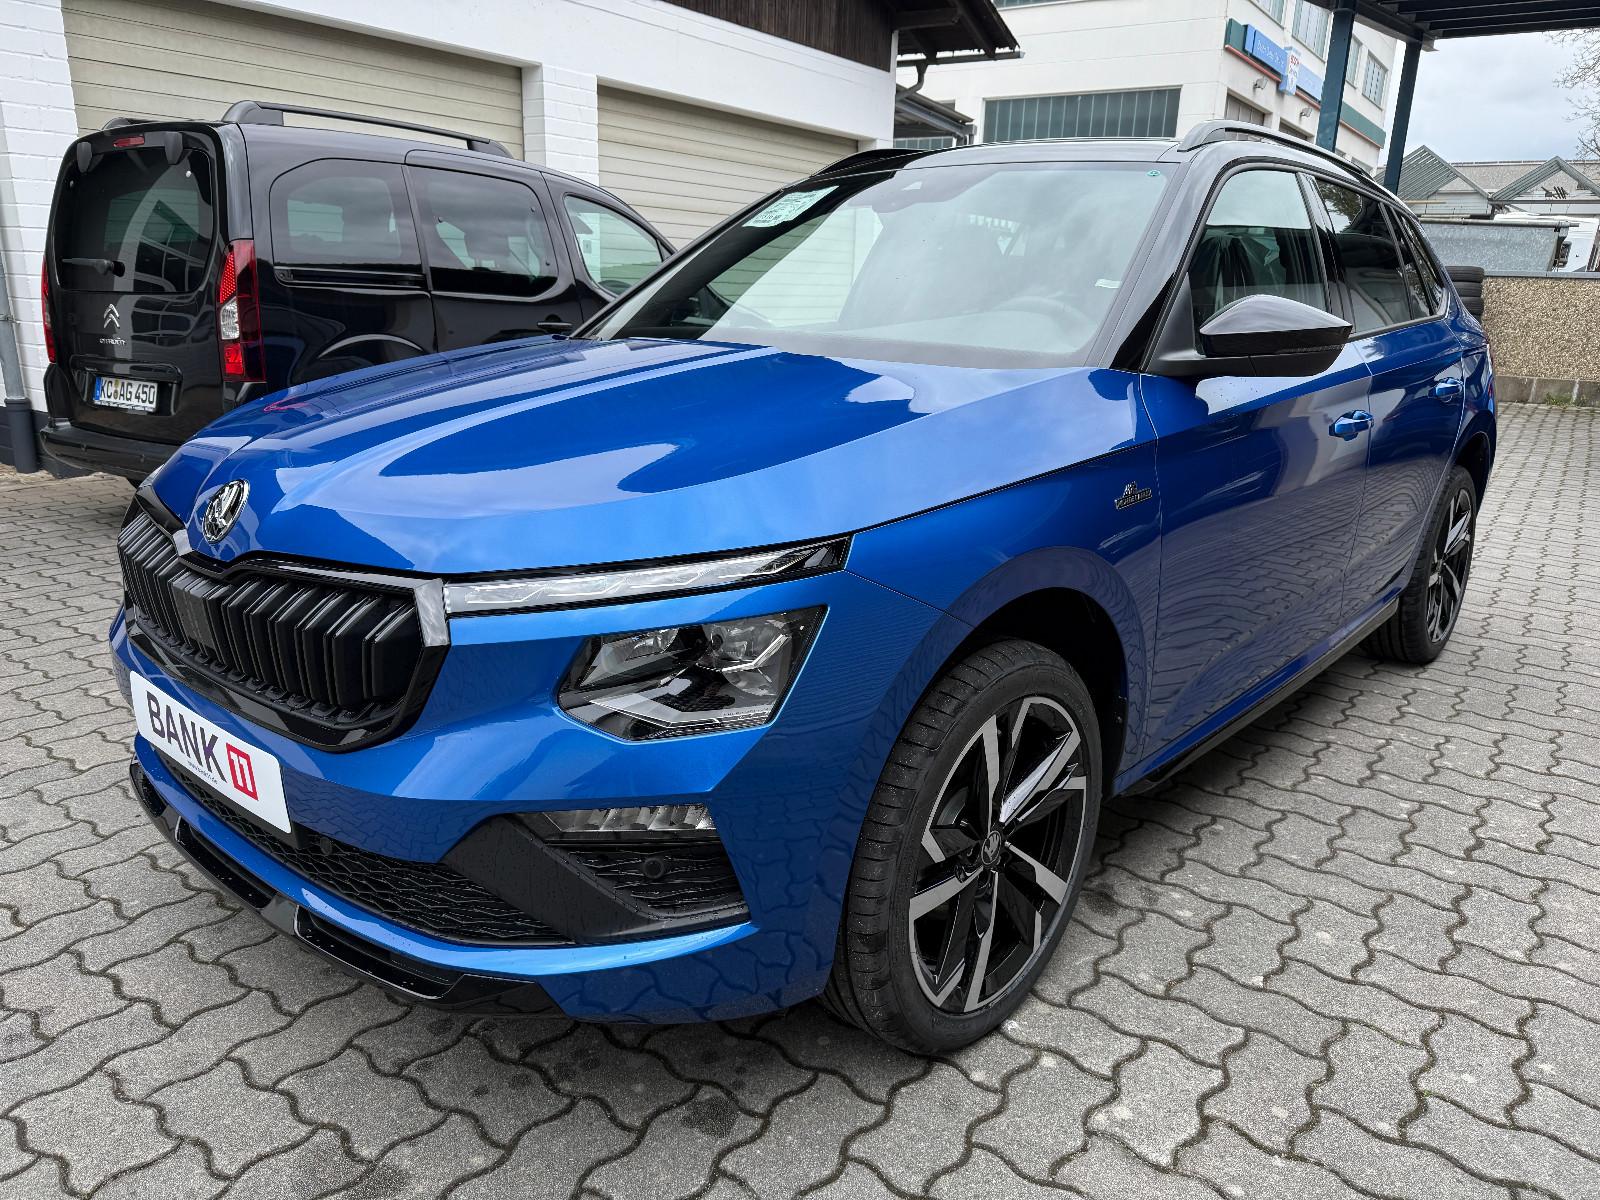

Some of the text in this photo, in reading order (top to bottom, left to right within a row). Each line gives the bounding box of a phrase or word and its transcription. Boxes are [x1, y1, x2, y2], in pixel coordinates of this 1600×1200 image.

[100, 379, 156, 405] KC AG 450
[146, 690, 227, 783] BANK
